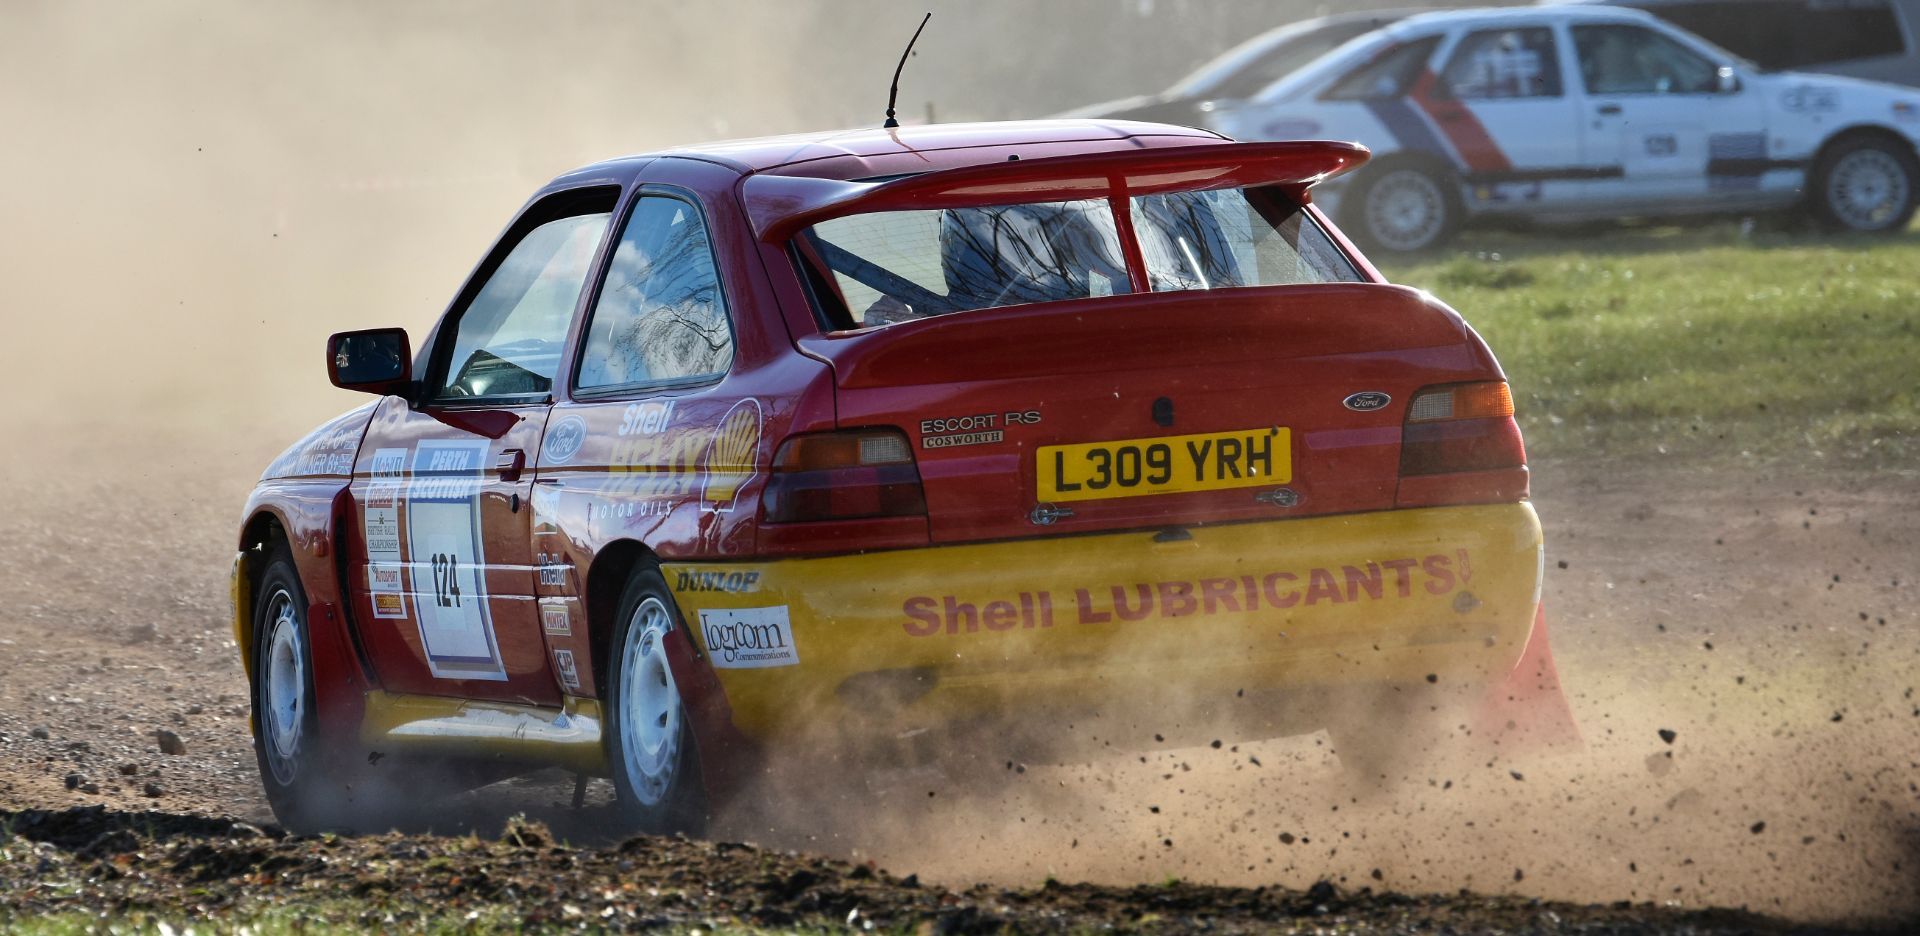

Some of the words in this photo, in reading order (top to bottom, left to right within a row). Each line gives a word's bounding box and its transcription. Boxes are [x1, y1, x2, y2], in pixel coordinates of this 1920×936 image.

[619, 401, 675, 435] Shell
[921, 414, 998, 433] ESCORT
[1005, 411, 1042, 426] RS
[551, 423, 578, 452] Ford
[926, 432, 1000, 447] COSWORTH
[429, 450, 471, 470] PERTH
[1055, 443, 1172, 492] L309
[1186, 435, 1272, 482] YRH
[413, 479, 472, 499] SCOTTISH
[591, 502, 633, 519] MOTOR
[641, 501, 672, 516] OILS
[431, 553, 460, 607] 124
[676, 572, 760, 592] DUNLOP
[545, 612, 568, 629] MINTEX
[901, 591, 1053, 637] Shell
[701, 614, 787, 663] Logicom
[735, 650, 791, 661] Communications
